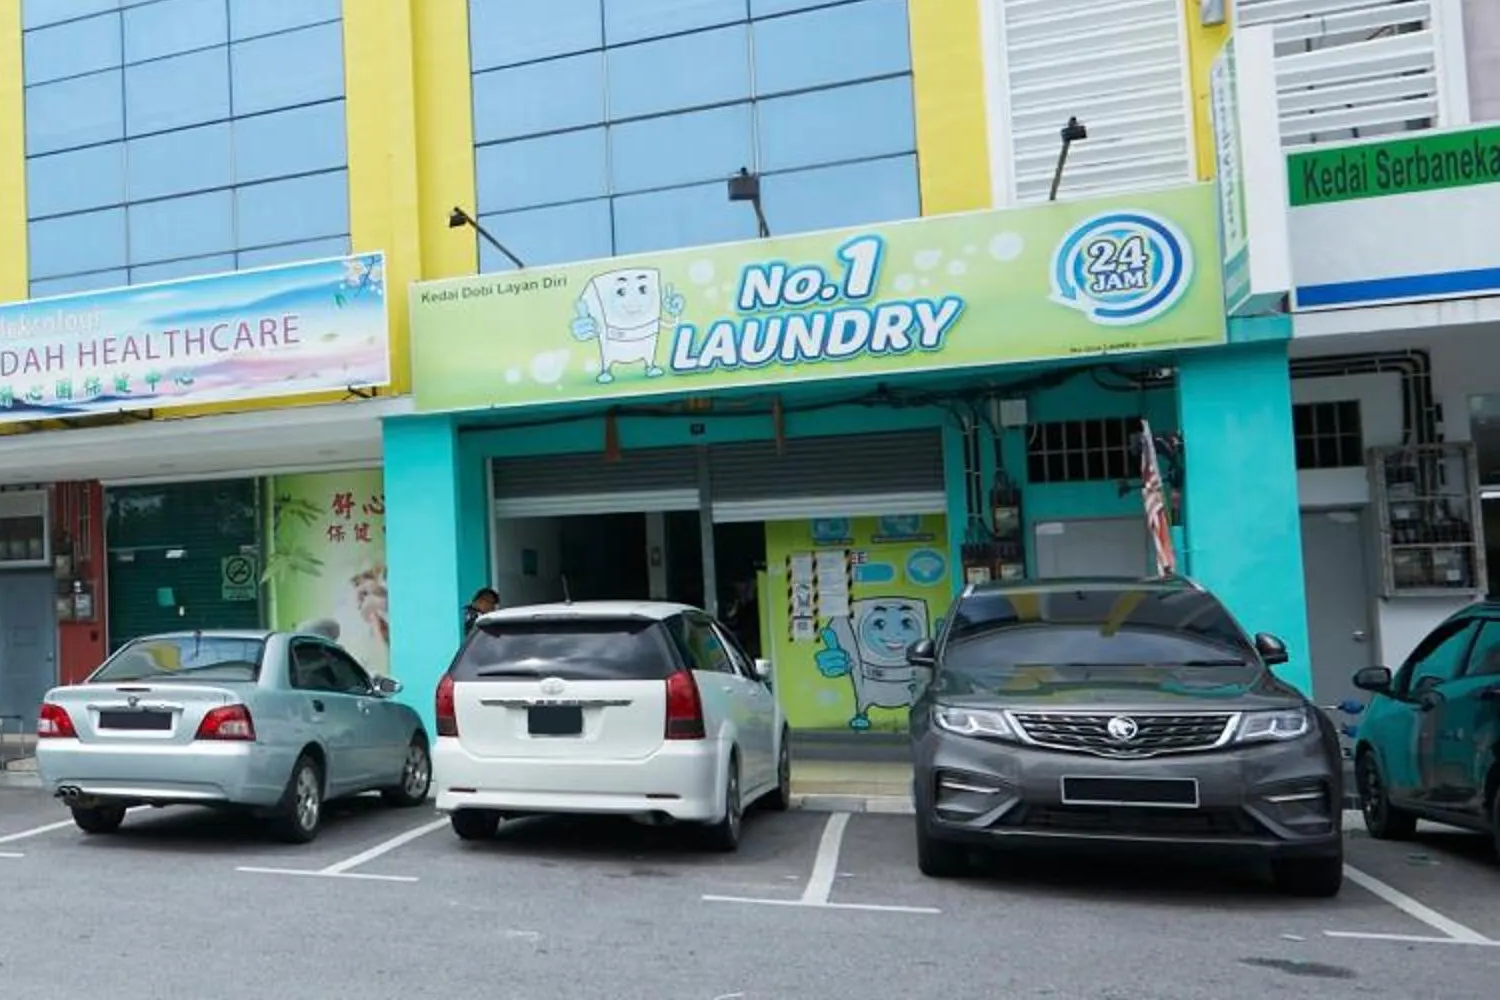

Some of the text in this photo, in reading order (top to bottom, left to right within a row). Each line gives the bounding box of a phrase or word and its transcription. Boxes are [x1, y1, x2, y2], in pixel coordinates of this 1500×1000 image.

[1302, 135, 1500, 199] Kedai Serbaneka
[739, 235, 882, 311] No.1
[1088, 236, 1149, 274] 24
[1093, 270, 1146, 292] JAM
[421, 276, 568, 304] Kedai Dobi Layan Diri
[78, 315, 301, 370] HEALTHCARE
[671, 297, 964, 375] LAUNDRY
